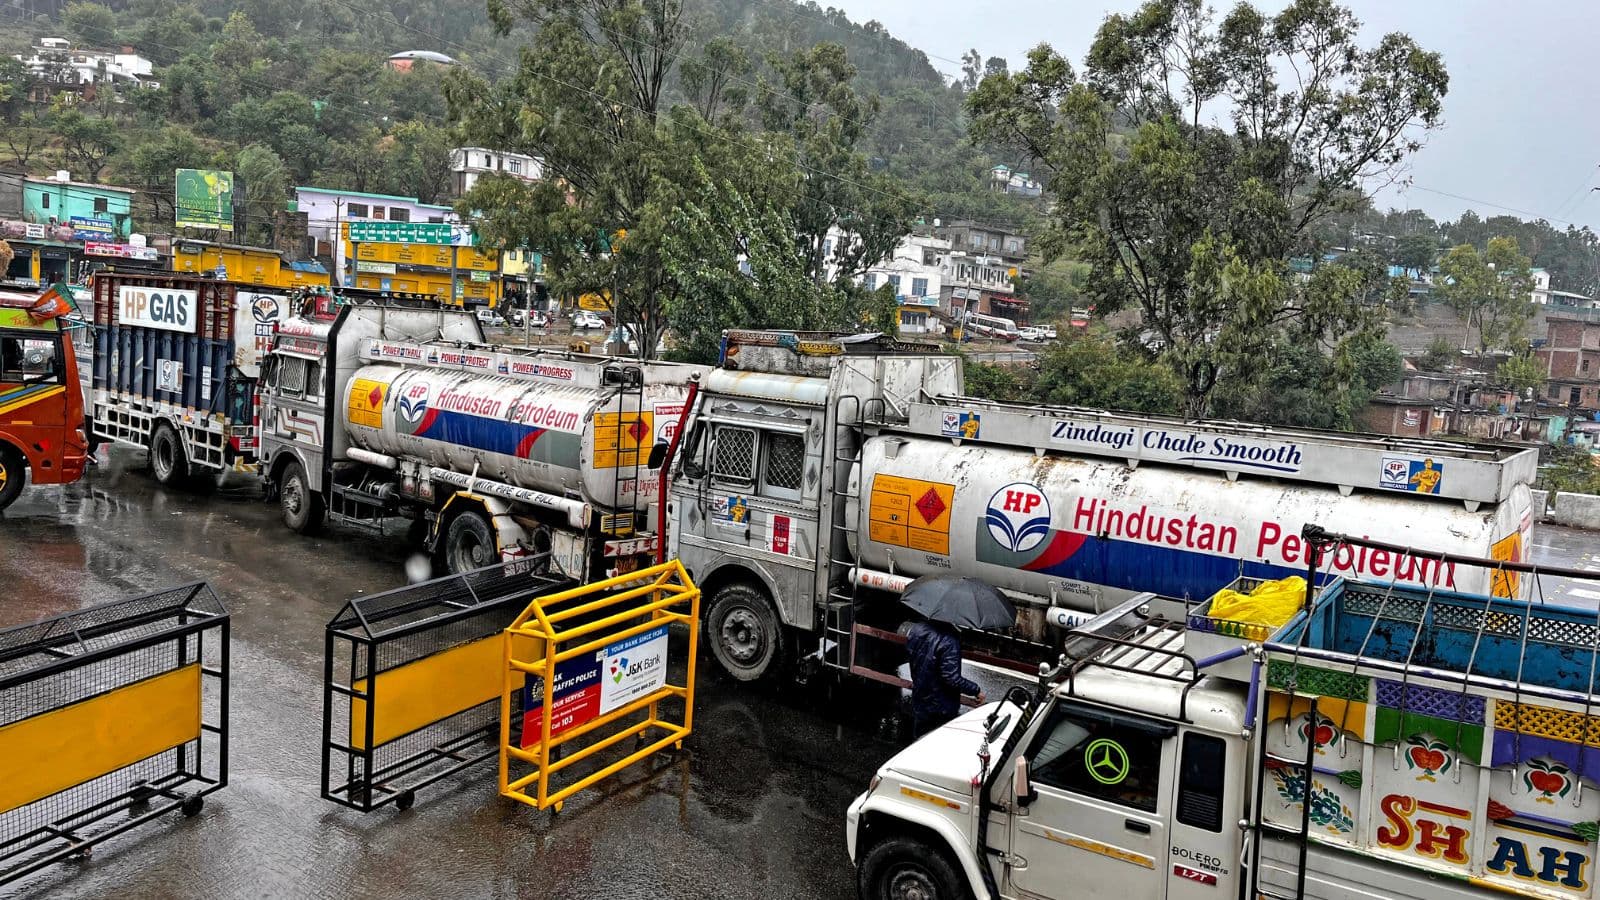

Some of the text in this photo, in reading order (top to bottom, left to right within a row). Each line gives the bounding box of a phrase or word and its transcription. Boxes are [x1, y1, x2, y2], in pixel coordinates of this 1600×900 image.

[125, 291, 188, 326] HP GAS
[260, 300, 273, 309] HP
[383, 346, 400, 356] POWER
[441, 353, 489, 367] POWER PROTECT
[513, 362, 573, 379] POWER PROGRESS
[409, 385, 427, 398] HP
[436, 387, 580, 431] Hindustan Petroleum
[1052, 421, 1302, 465] Zindagi Chale Smooth
[1003, 490, 1041, 513] HP
[1073, 497, 1238, 553] Hindustan
[611, 644, 624, 653] YOUR
[625, 639, 638, 648] BANK
[639, 633, 651, 642] SINCE
[626, 654, 660, 677] J&K Bank
[553, 669, 597, 692] RAFFIC POLICE
[554, 673, 563, 682] &K
[565, 690, 586, 704] SERVICE
[561, 715, 573, 726] 103
[1377, 794, 1590, 891] SH AH
[1171, 846, 1221, 866] BOLERO
